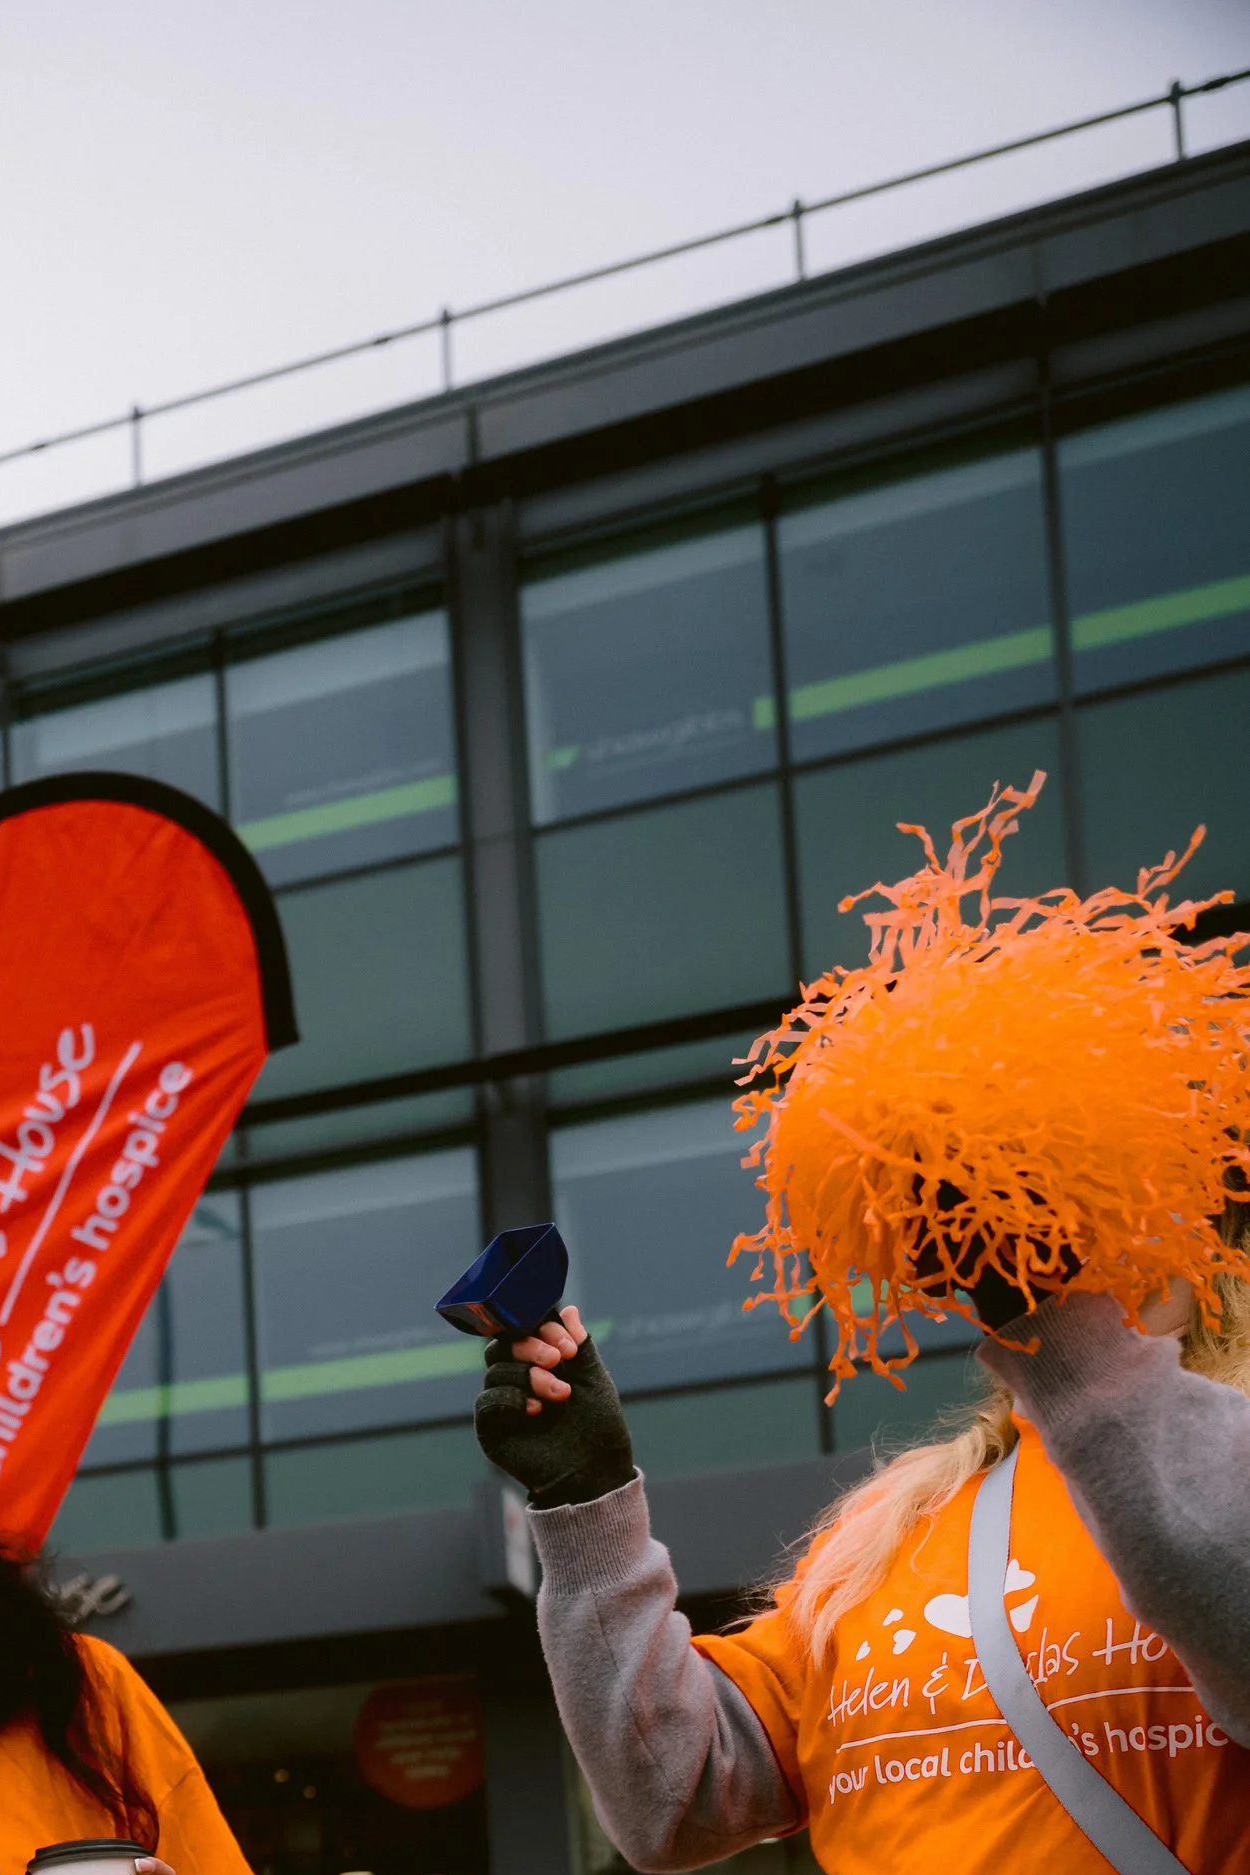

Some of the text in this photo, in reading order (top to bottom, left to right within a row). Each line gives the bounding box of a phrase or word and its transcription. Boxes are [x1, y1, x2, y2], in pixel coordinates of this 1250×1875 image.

[71, 1060, 194, 1251] hospice
[826, 1667, 910, 1727] Helen
[921, 1652, 950, 1715] &
[961, 1626, 1081, 1701] Dlas
[874, 1747, 953, 1784] local
[960, 1722, 1100, 1775] chil's
[1103, 1715, 1229, 1758] hospic
